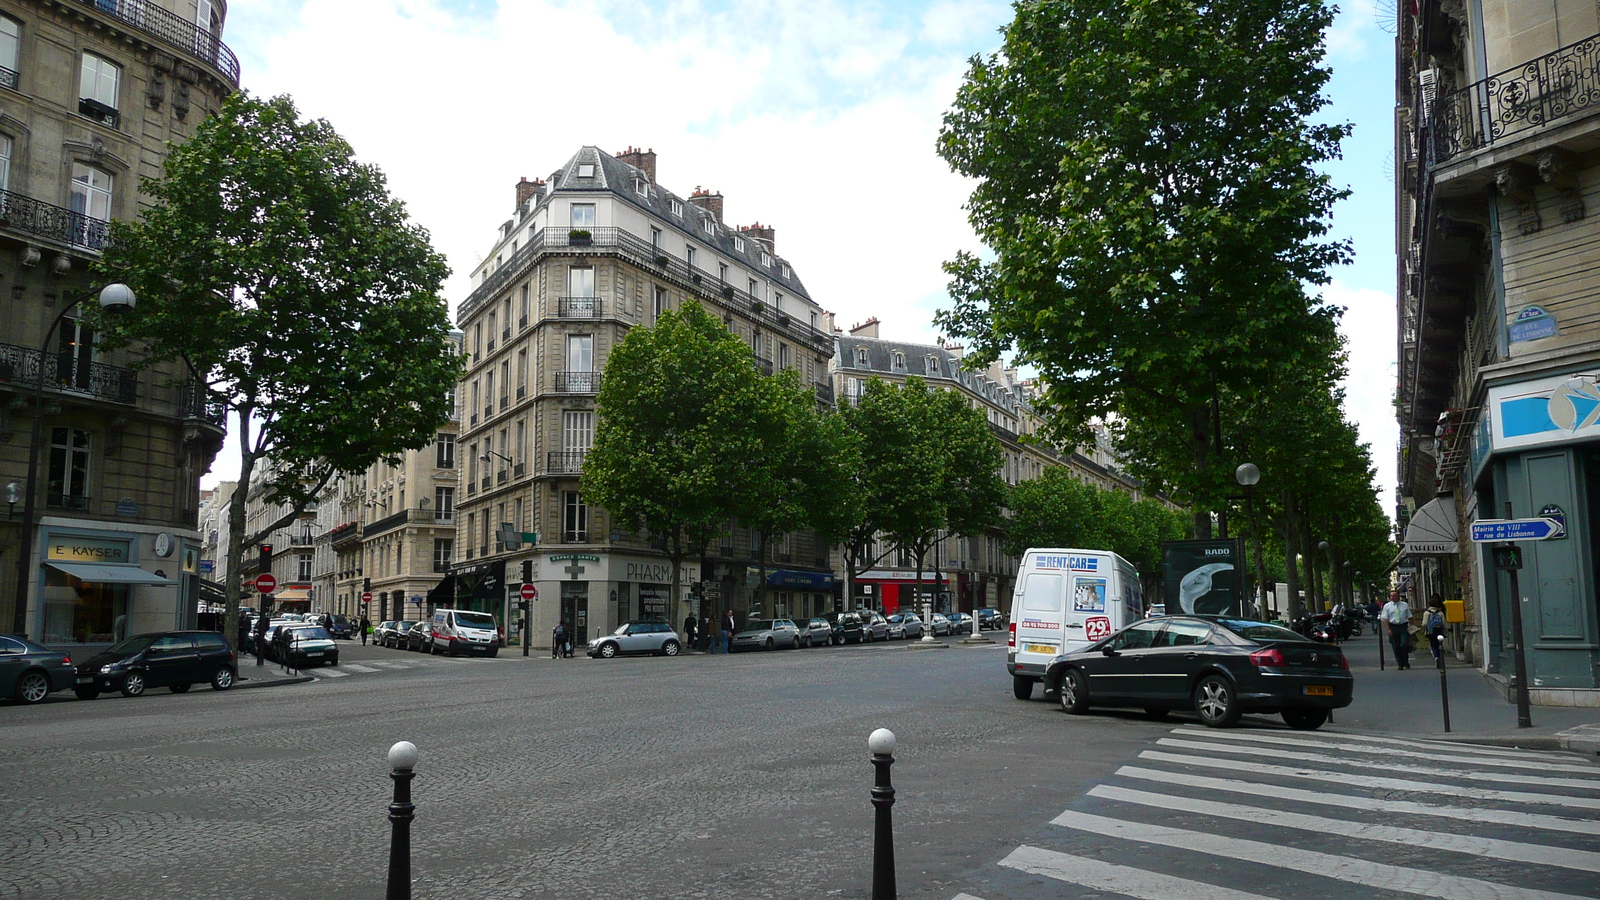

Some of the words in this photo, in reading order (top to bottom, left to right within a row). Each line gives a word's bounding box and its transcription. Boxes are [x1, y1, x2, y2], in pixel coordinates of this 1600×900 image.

[1522, 326, 1553, 338] LISBONNE
[56, 545, 64, 555] E
[72, 546, 122, 558] KAYSER
[1046, 556, 1068, 568] RENT
[1069, 557, 1088, 569] CAR
[627, 562, 696, 583] PHARMCIE
[1087, 620, 1106, 637] 29
